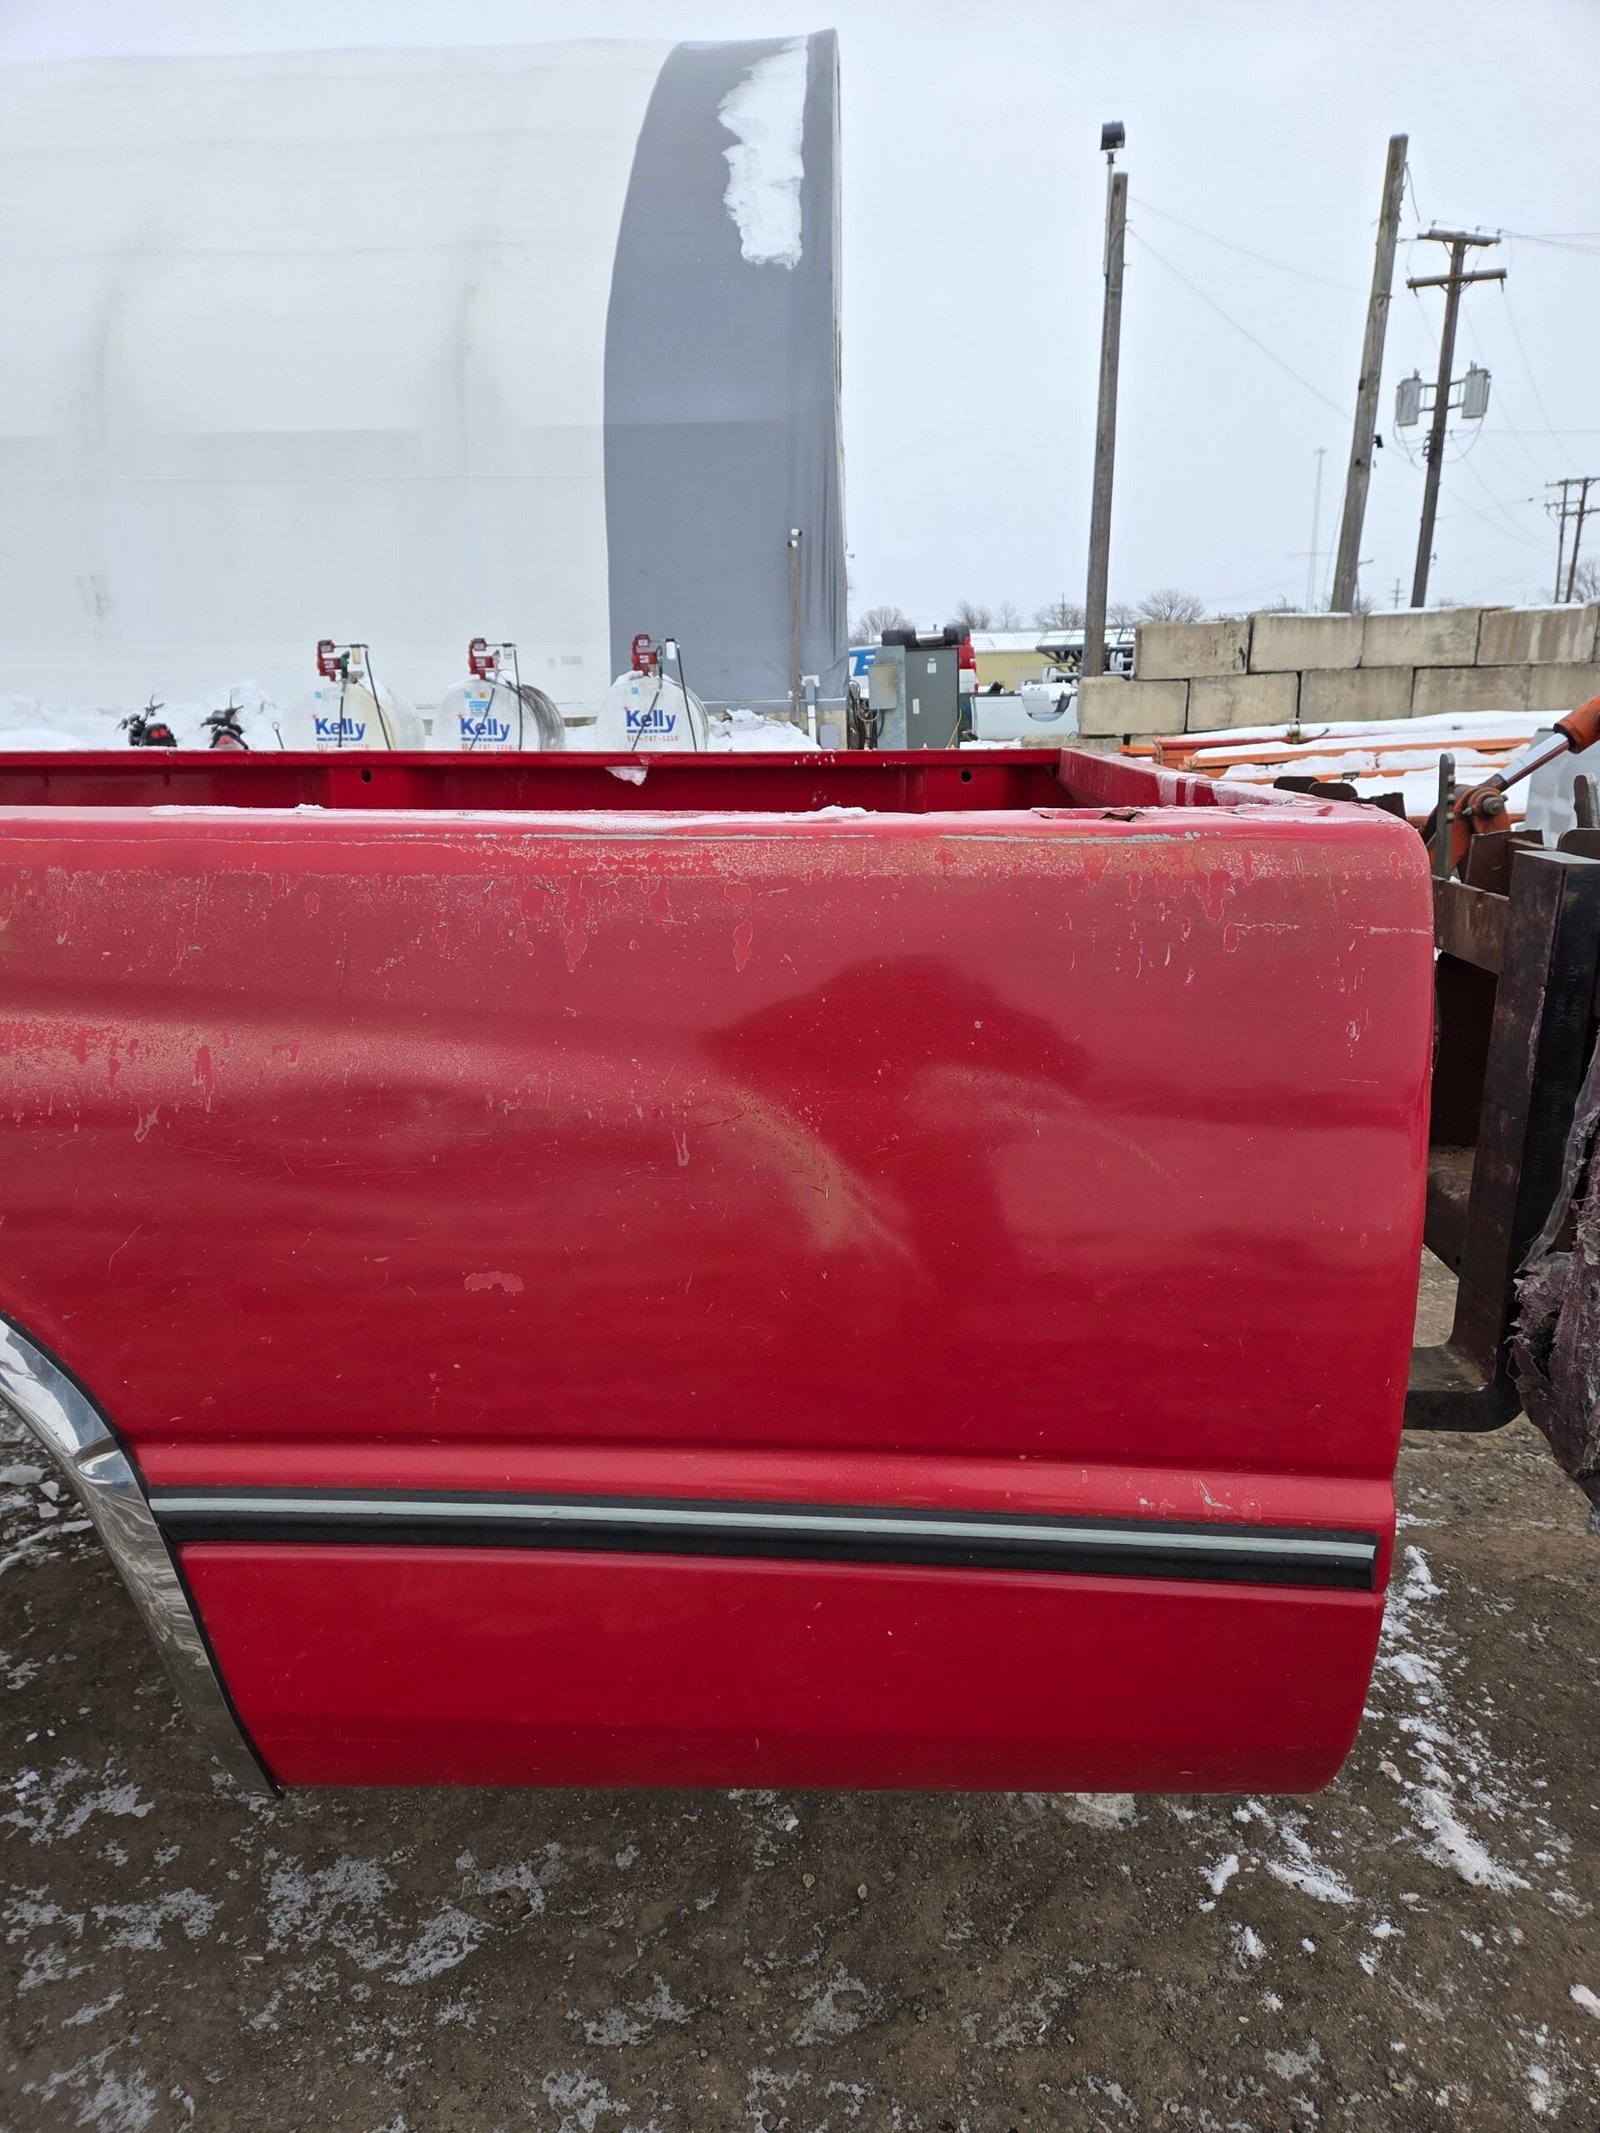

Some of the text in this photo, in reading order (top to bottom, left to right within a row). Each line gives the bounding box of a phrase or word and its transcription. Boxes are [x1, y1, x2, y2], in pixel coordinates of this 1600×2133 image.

[315, 718, 366, 741] Kelly
[460, 718, 510, 742] Kelly
[626, 710, 676, 733] Kelly
